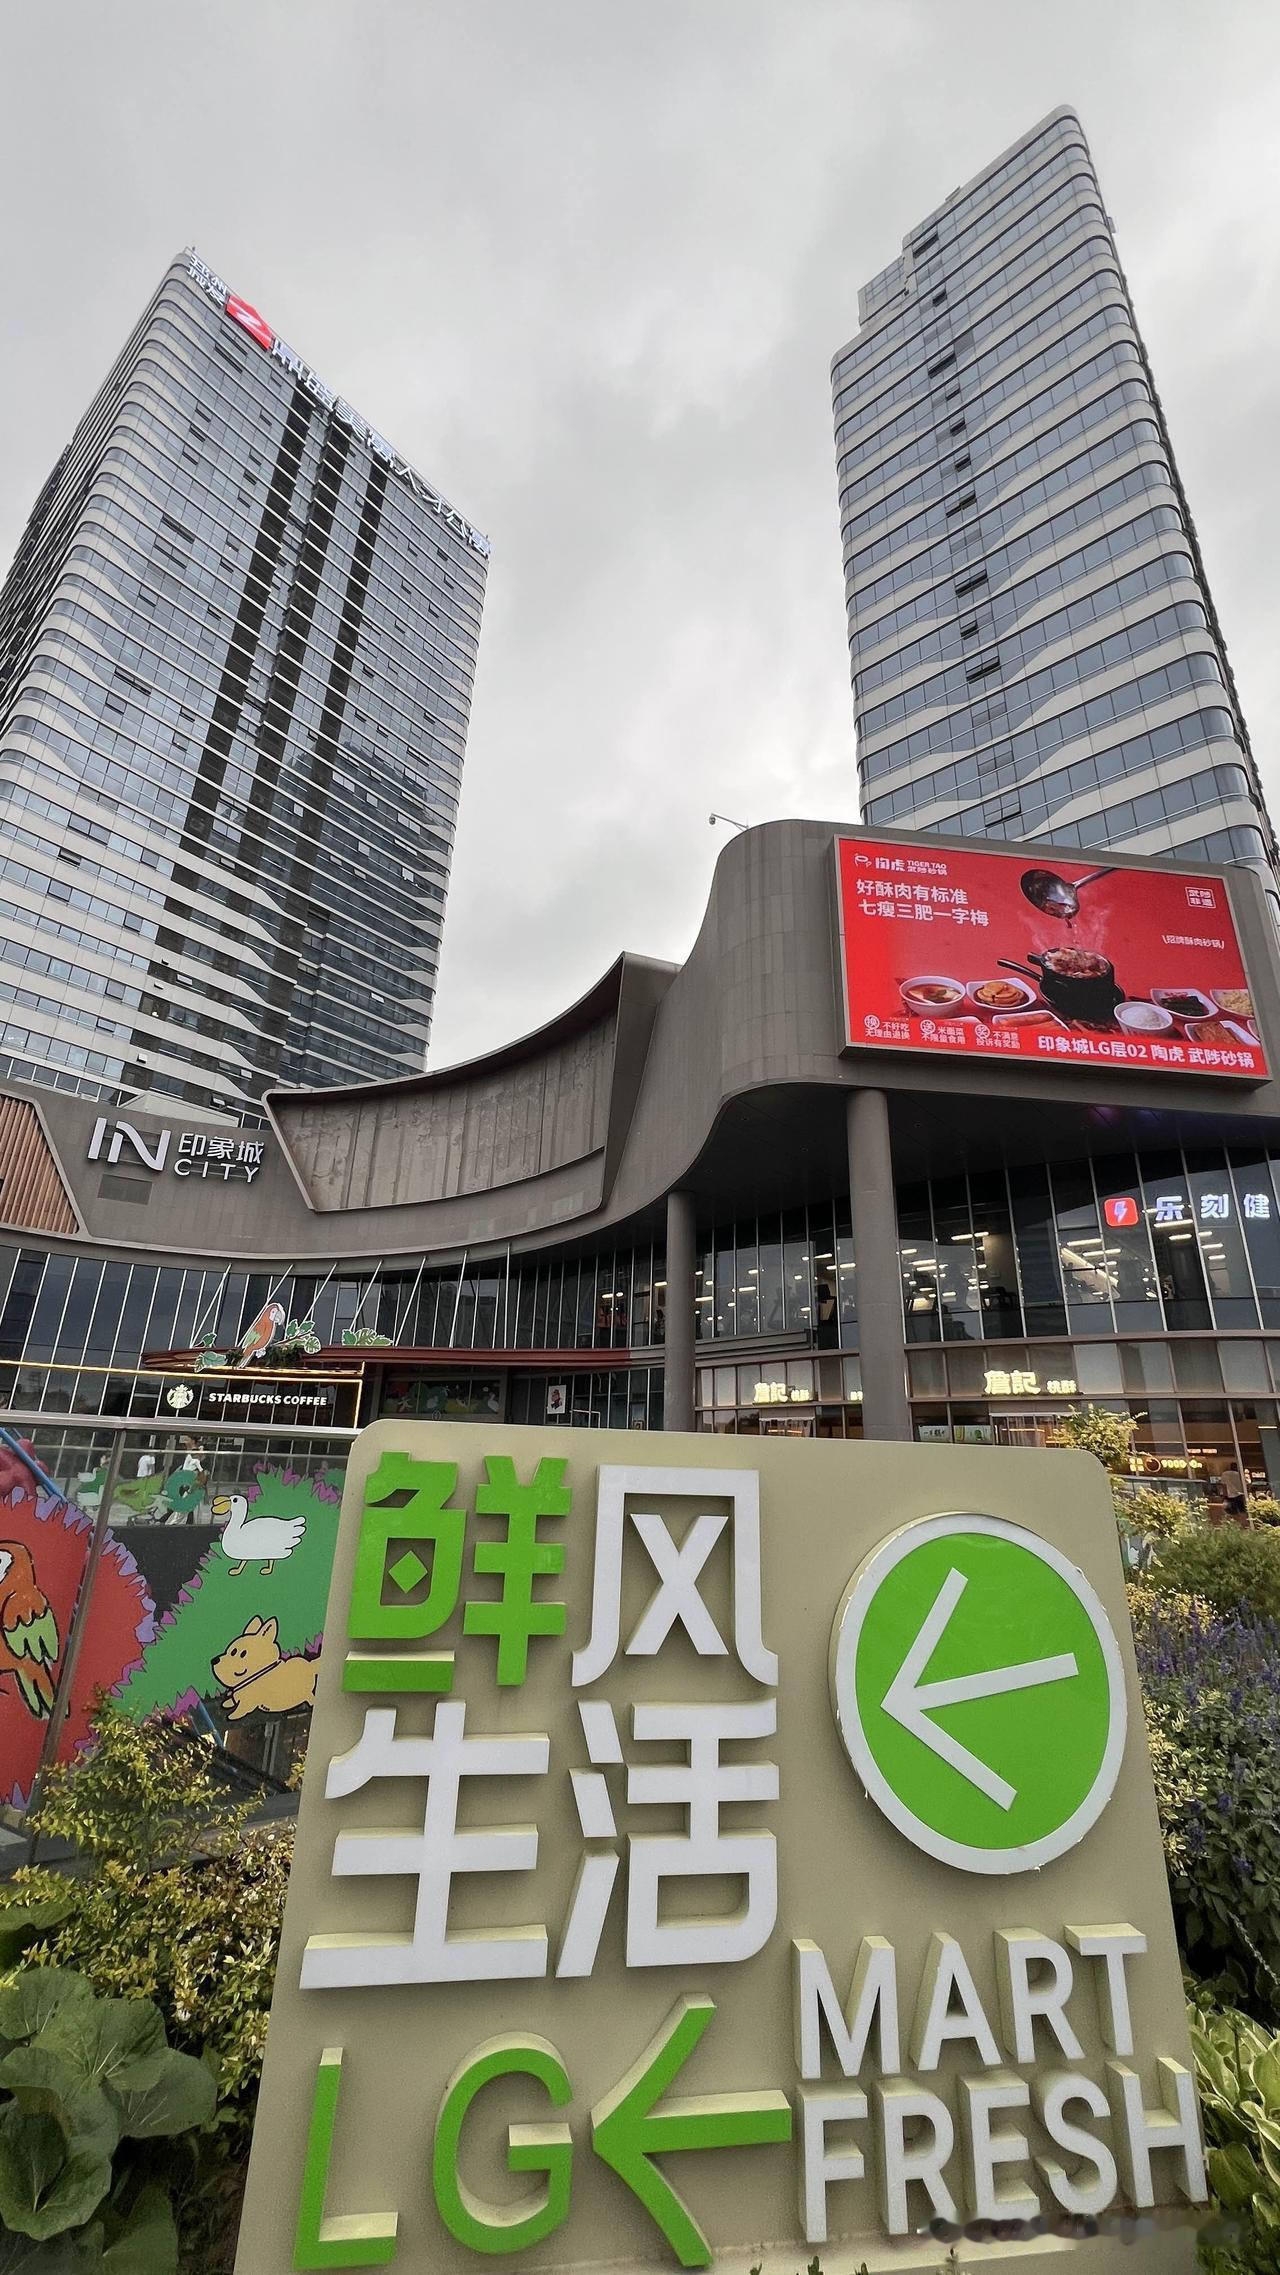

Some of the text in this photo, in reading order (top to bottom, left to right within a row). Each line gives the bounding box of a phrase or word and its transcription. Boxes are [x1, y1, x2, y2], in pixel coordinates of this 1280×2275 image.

[907, 860, 930, 868] TIGER
[856, 878, 969, 905] 好酥肉有标准
[858, 899, 989, 927] 七瘦三肥一字梅
[1037, 1035, 1255, 1069] 印象城LG层02 陶虎 武陟砂锅
[178, 1132, 264, 1164] 印象城
[174, 1158, 260, 1183] CITY
[1155, 1193, 1271, 1221] 乐刻健
[208, 1392, 328, 1406] STARBUCKS COFFEE
[299, 1697, 781, 1990] 生活
[791, 1921, 1148, 2080] MART
[294, 2032, 574, 2269] LG
[796, 2056, 1209, 2244] FRESH
